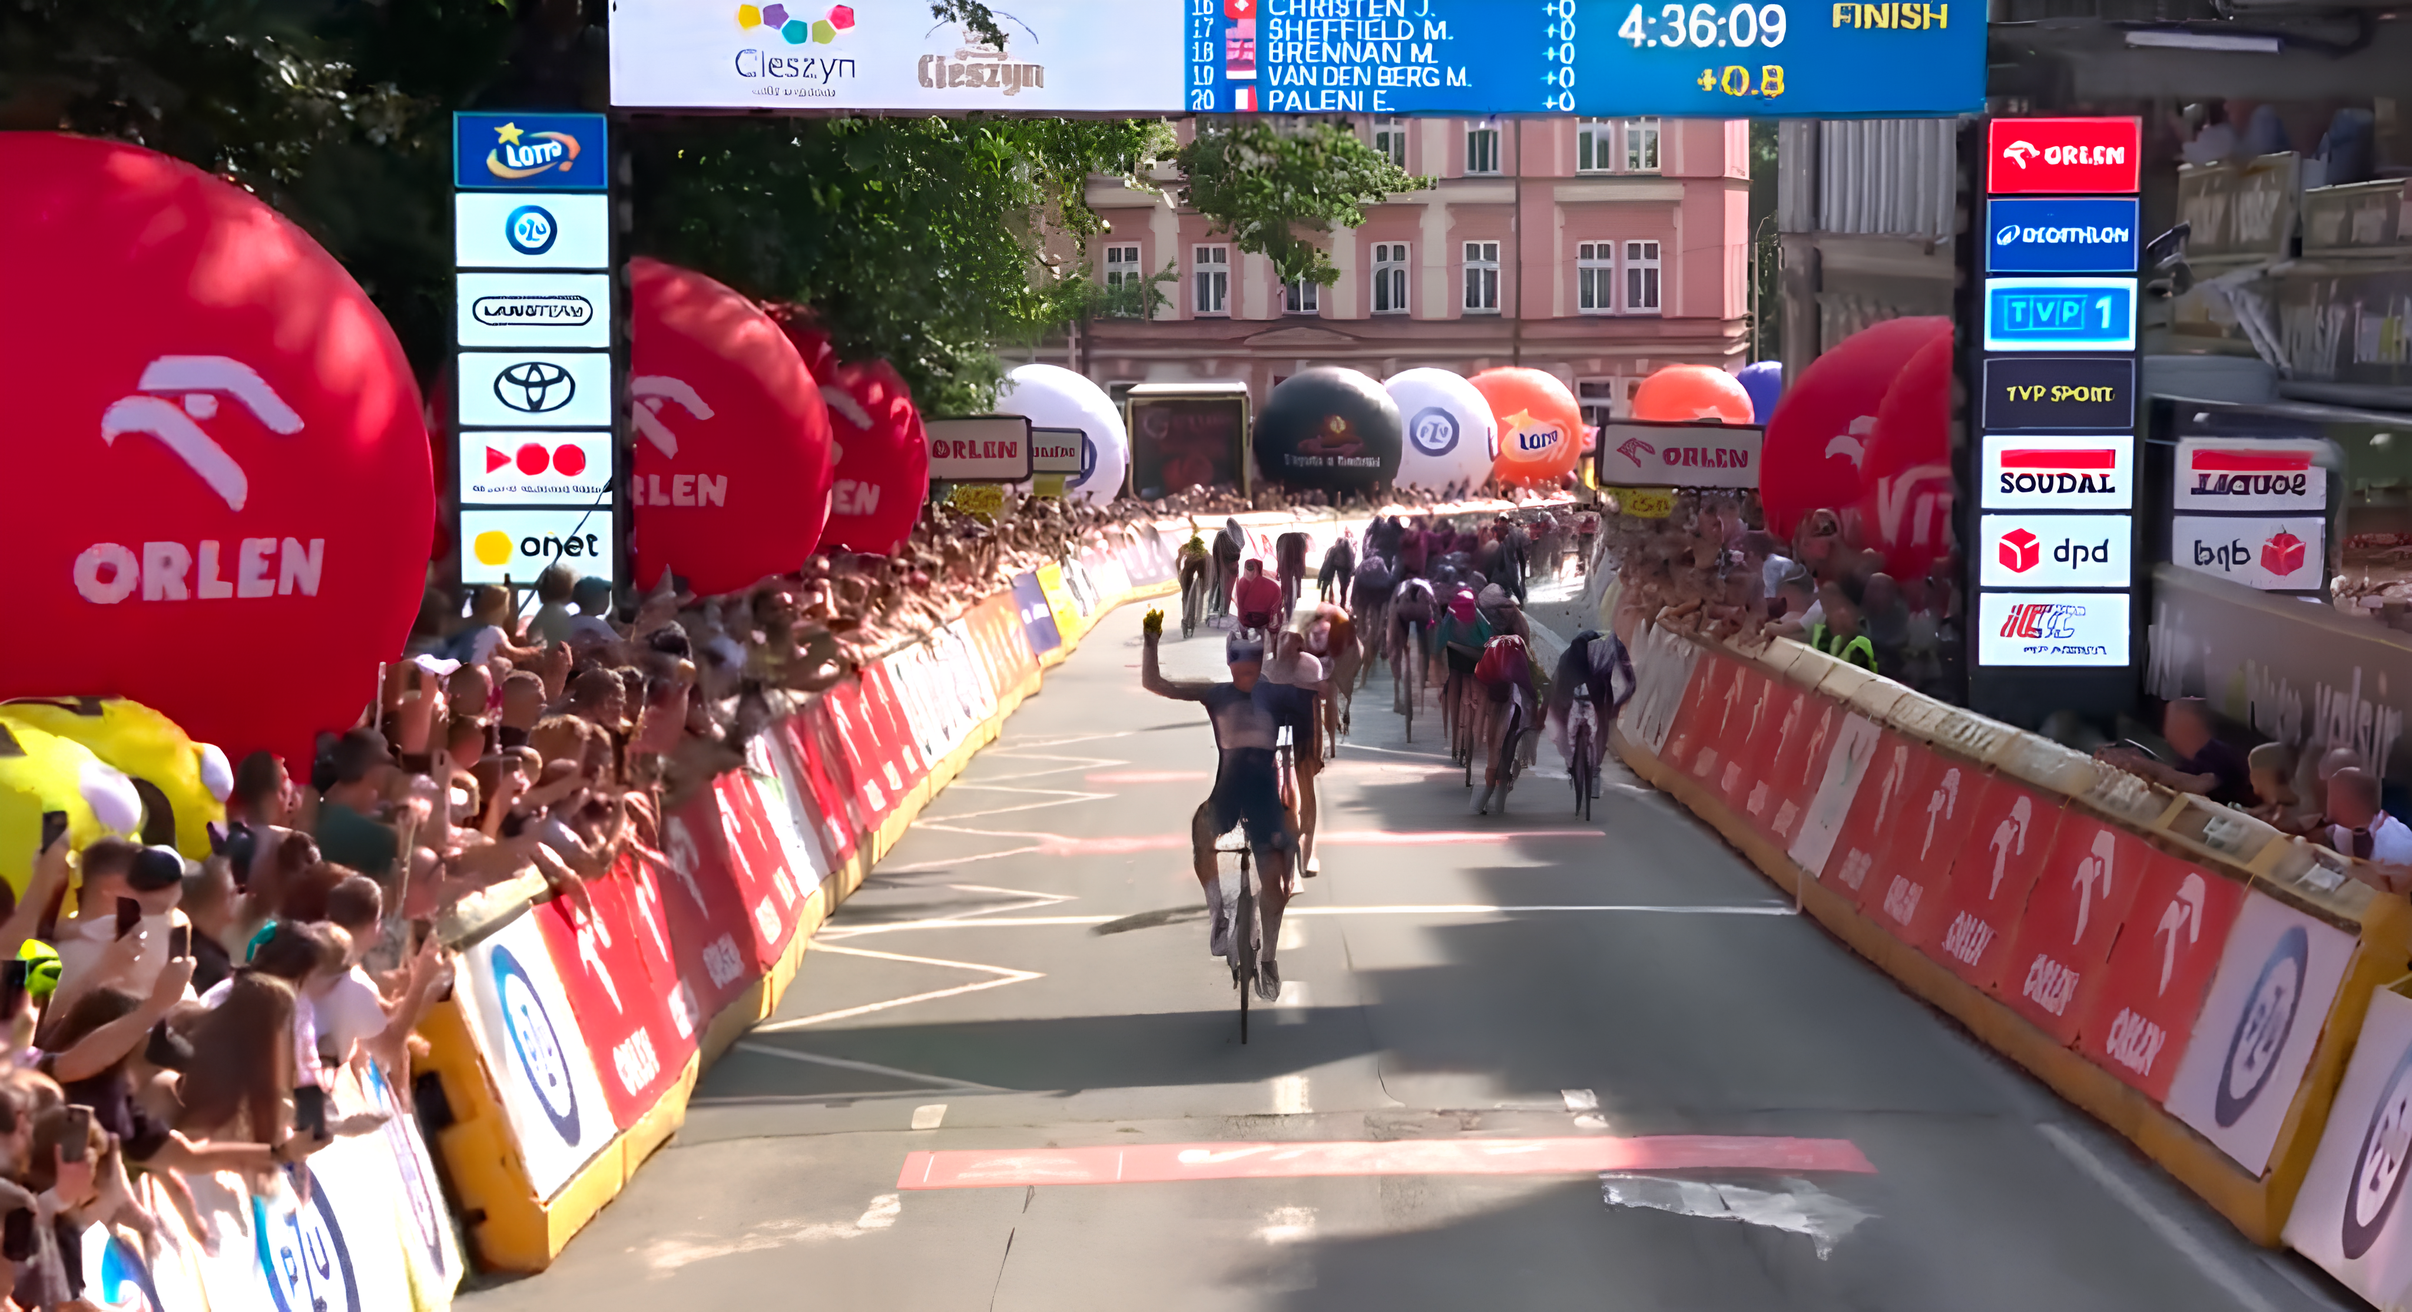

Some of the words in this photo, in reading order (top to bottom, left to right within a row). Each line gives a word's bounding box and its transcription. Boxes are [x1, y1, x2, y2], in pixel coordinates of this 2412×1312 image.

[1268, 0, 1405, 17] CHRISTEN
[1832, 3, 1947, 29] FINISH
[1192, 17, 1214, 39] 17
[1268, 18, 1415, 41] SHEFFIELD
[1423, 20, 1454, 40] M.
[1618, 3, 1787, 48] 4:36:09
[1268, 41, 1401, 63] BRENNAN
[1541, 42, 1576, 65] +0
[1267, 65, 1317, 86] VAN
[1323, 65, 1371, 86] DEN
[1377, 65, 1440, 87] BERG
[1446, 65, 1473, 87] M.
[1190, 88, 1215, 111] 20
[1268, 89, 1363, 111] PALENI
[2044, 145, 2125, 166] ORLEN
[2011, 301, 2080, 323] TVP
[2096, 296, 2112, 329] 1
[2006, 385, 2047, 402] TVP
[2000, 472, 2117, 494] SOUDAL
[520, 533, 599, 557] onet
[2053, 538, 2109, 570] dpd
[73, 537, 325, 604] ORLEN
